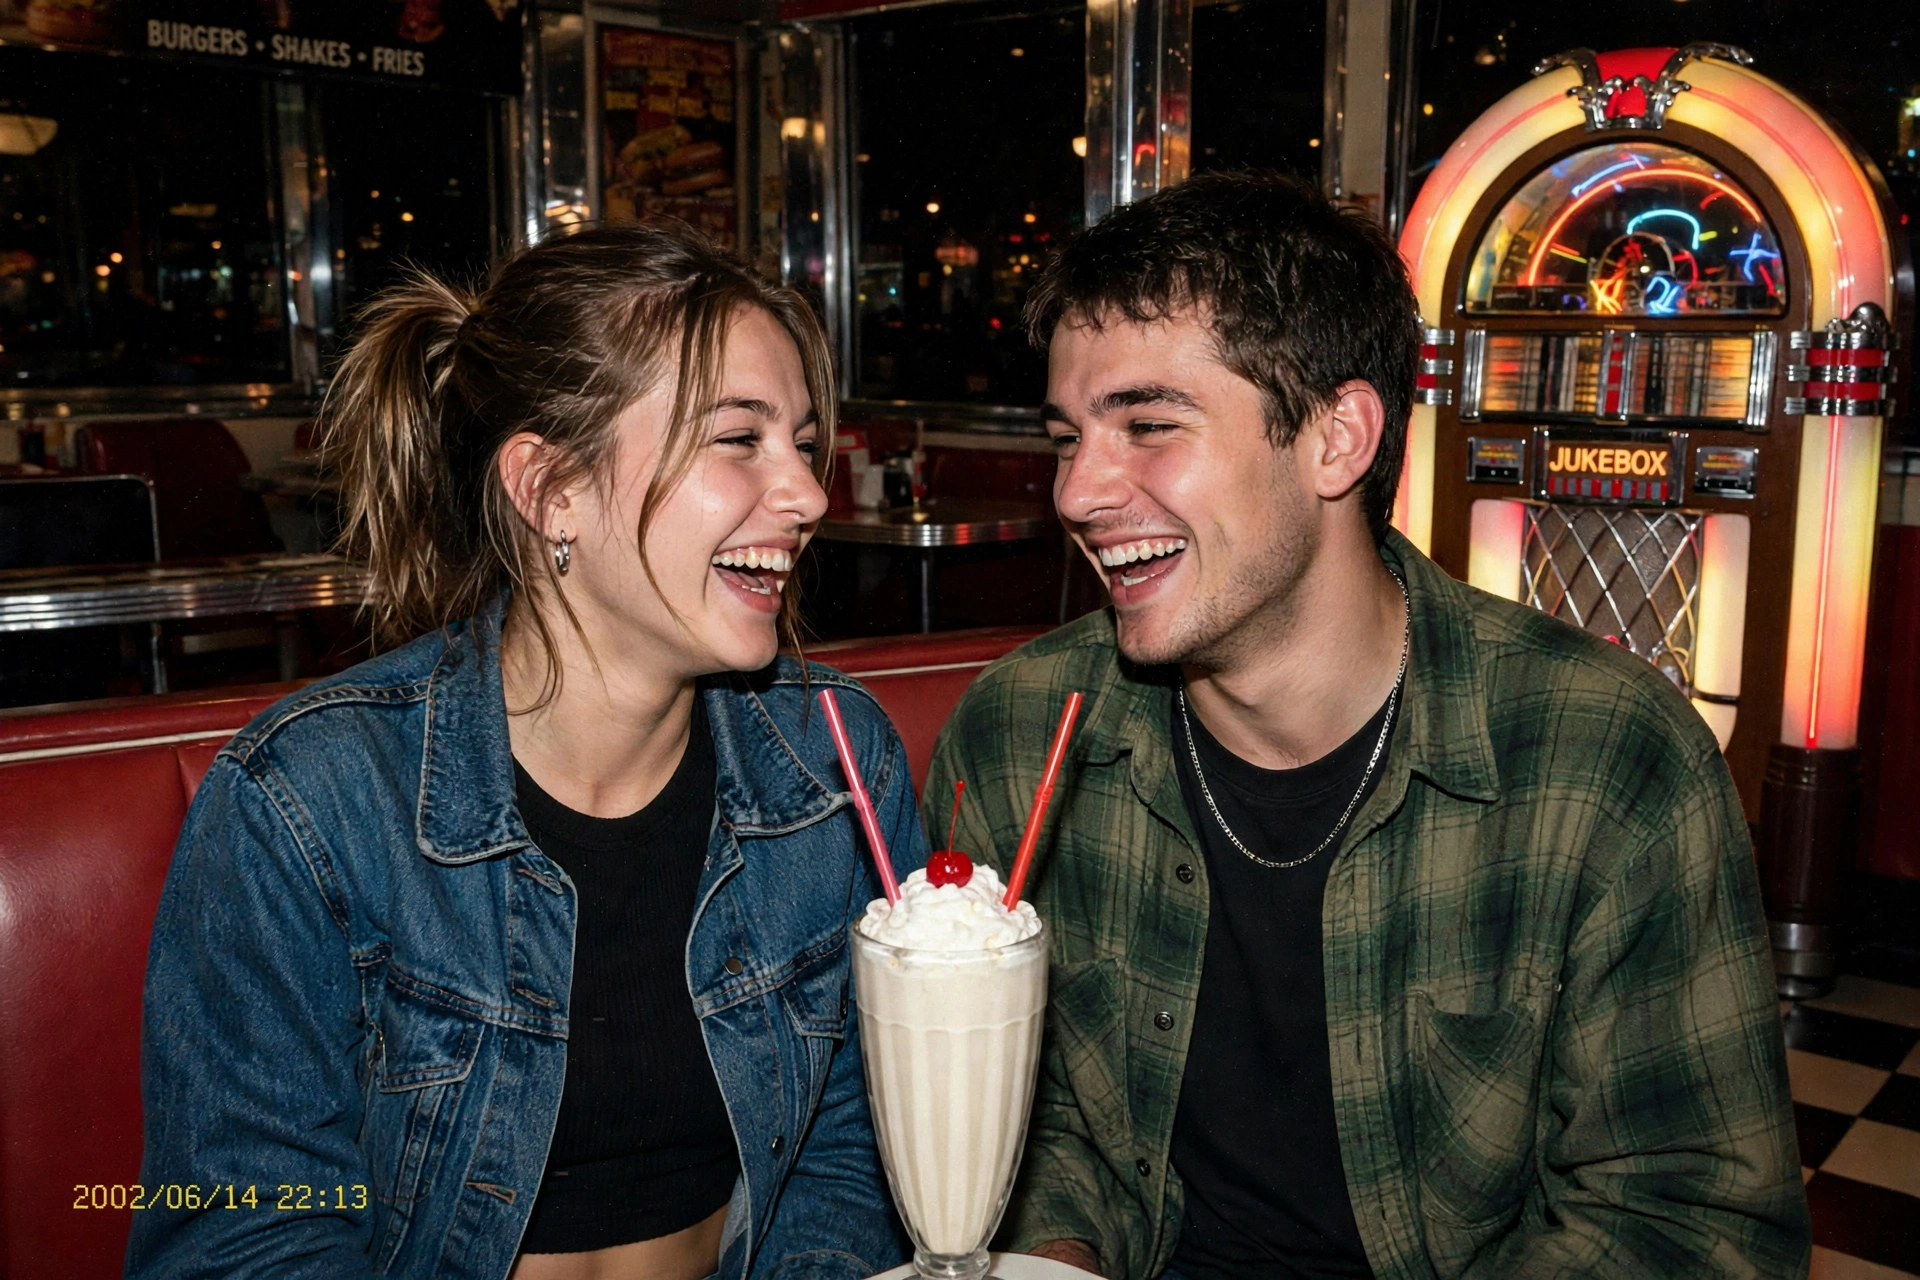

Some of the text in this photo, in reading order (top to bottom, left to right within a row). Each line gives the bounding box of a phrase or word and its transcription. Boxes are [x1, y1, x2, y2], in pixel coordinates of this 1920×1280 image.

[146, 18, 425, 77] BURGERS SHAKES FRIES
[1549, 446, 1668, 476] JUKEBOX
